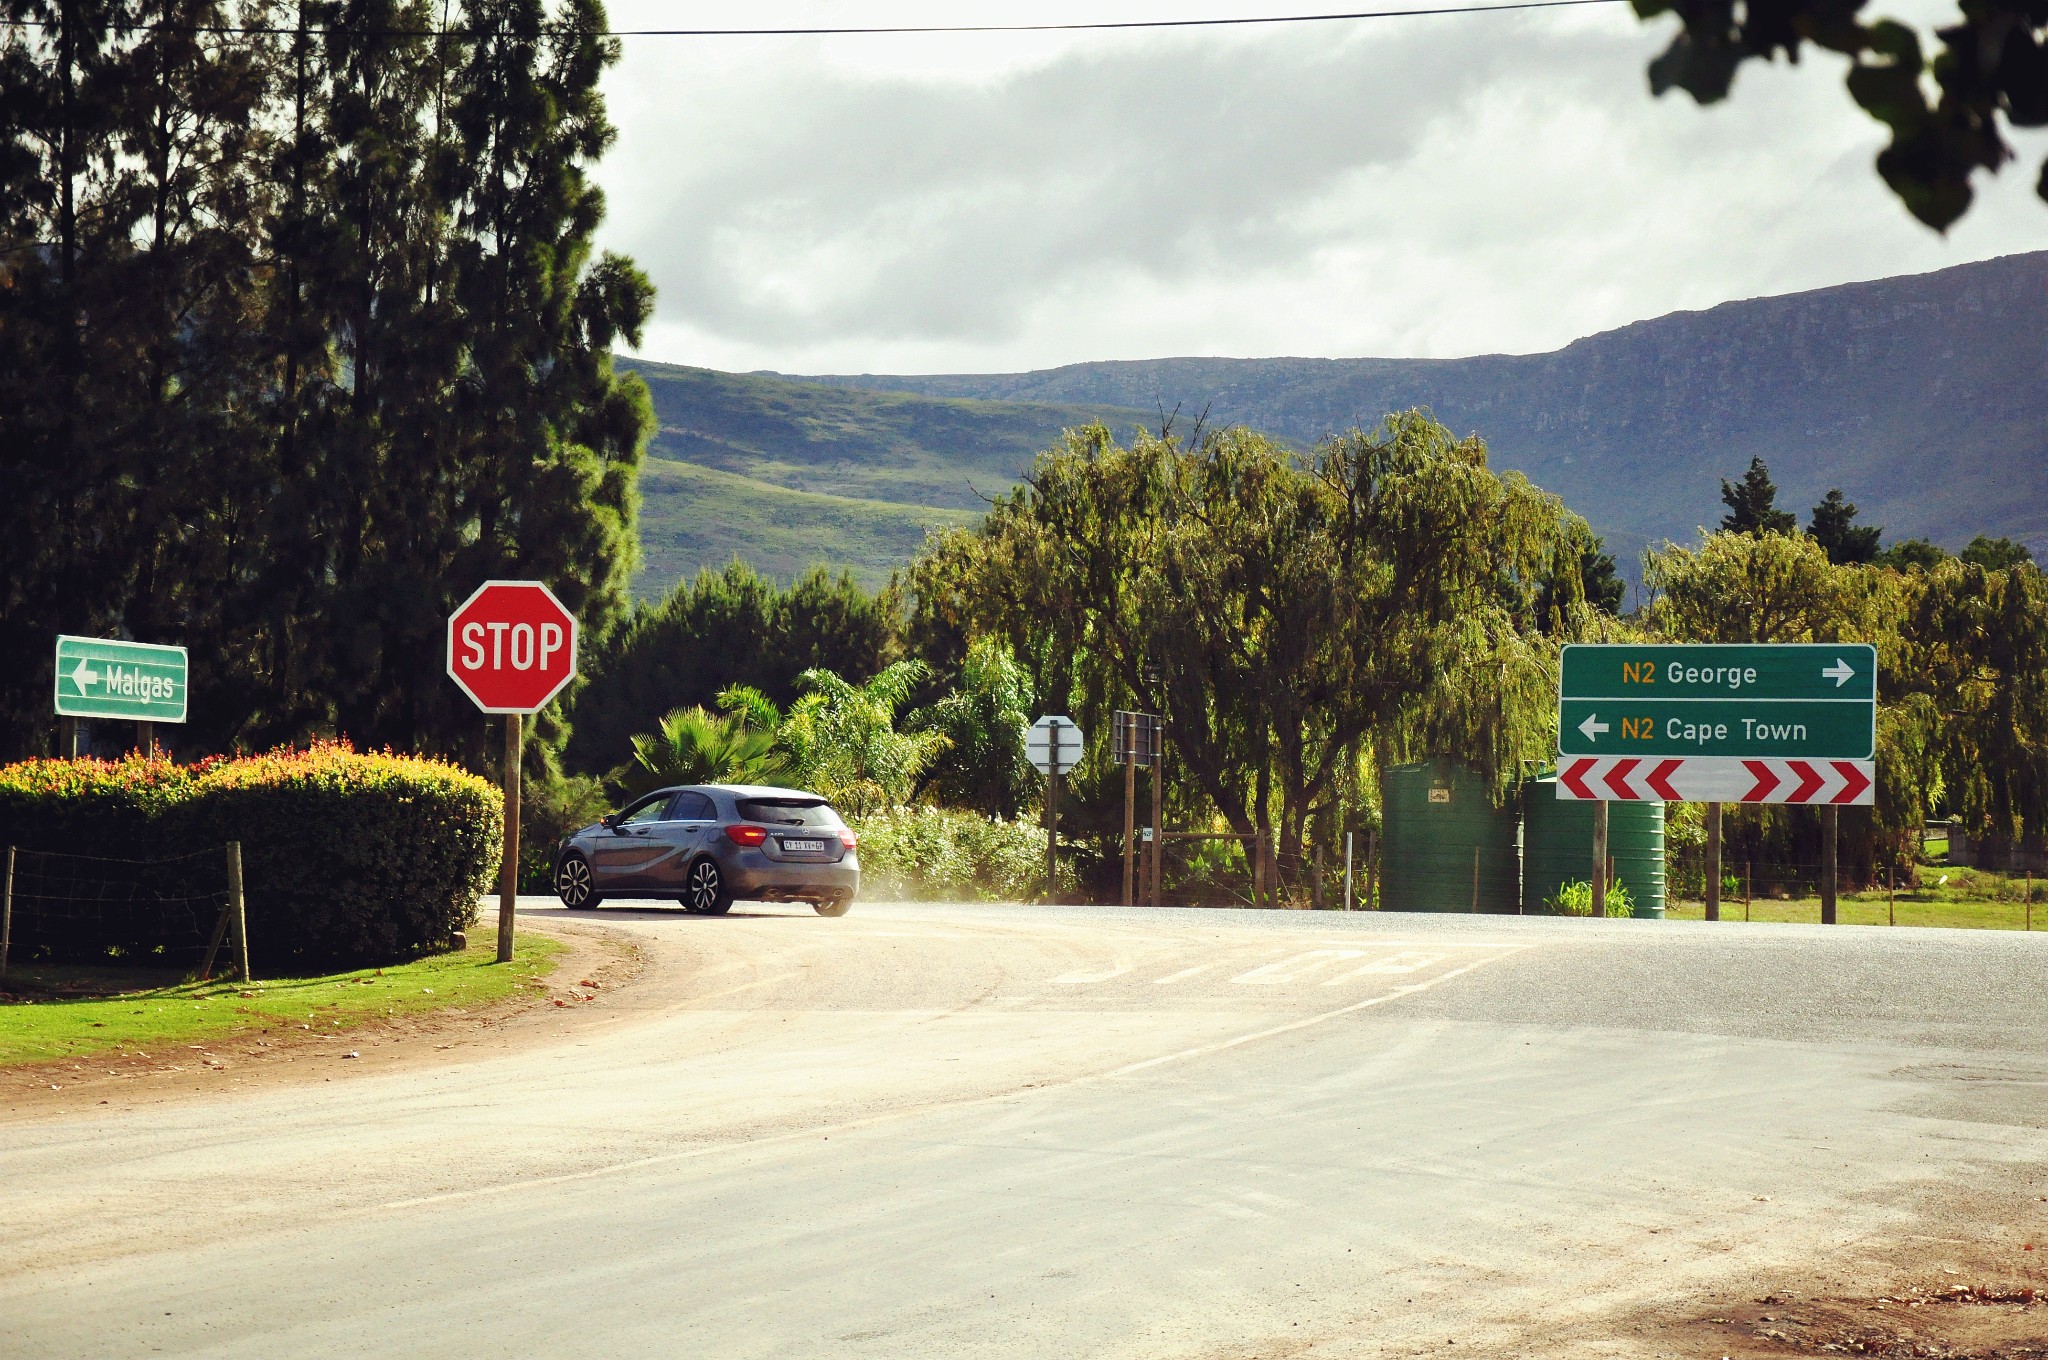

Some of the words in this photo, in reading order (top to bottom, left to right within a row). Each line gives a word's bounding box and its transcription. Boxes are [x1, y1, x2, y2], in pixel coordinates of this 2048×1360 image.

[461, 621, 563, 671] STOP
[106, 664, 174, 704] Malgas
[1622, 661, 1656, 684] N2
[1667, 661, 1757, 689] George
[1620, 717, 1654, 740] N2
[1666, 717, 1728, 746] Cape
[1741, 718, 1807, 741] Town
[795, 841, 802, 849] 11
